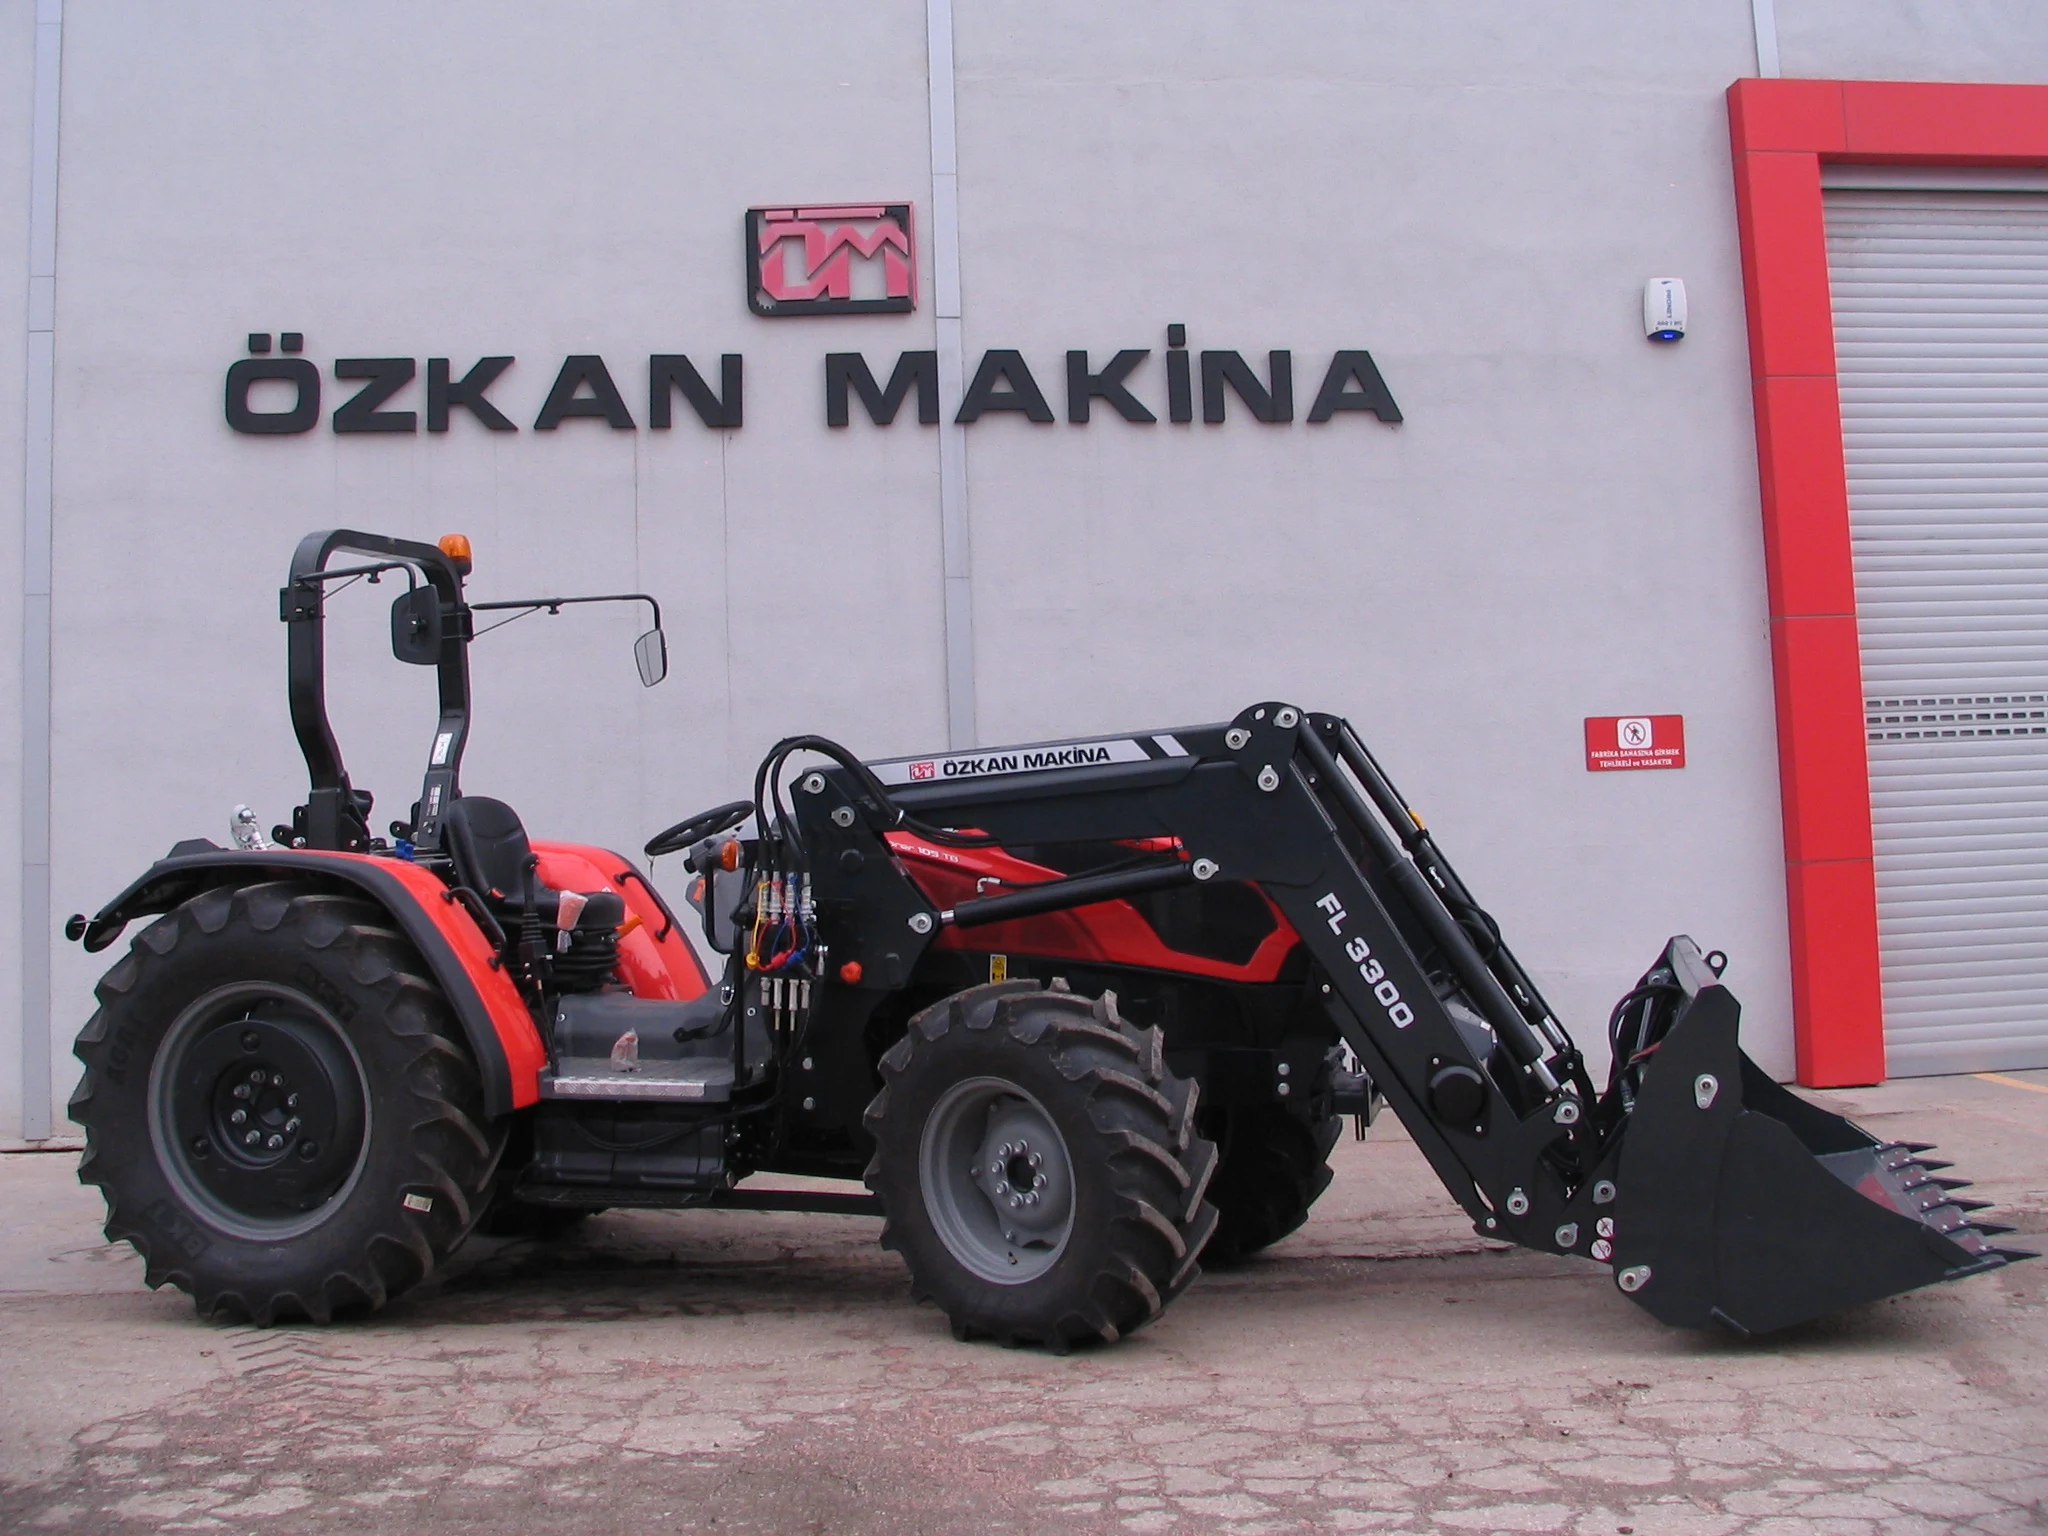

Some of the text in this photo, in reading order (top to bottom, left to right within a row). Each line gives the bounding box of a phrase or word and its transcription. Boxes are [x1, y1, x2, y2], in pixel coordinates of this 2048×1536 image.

[225, 323, 1404, 434] ÖZKAN MAKİNA
[943, 755, 1018, 777] ÖZKAN
[1023, 747, 1111, 768] MAKİNA
[1315, 892, 1415, 1029] FL 3300
